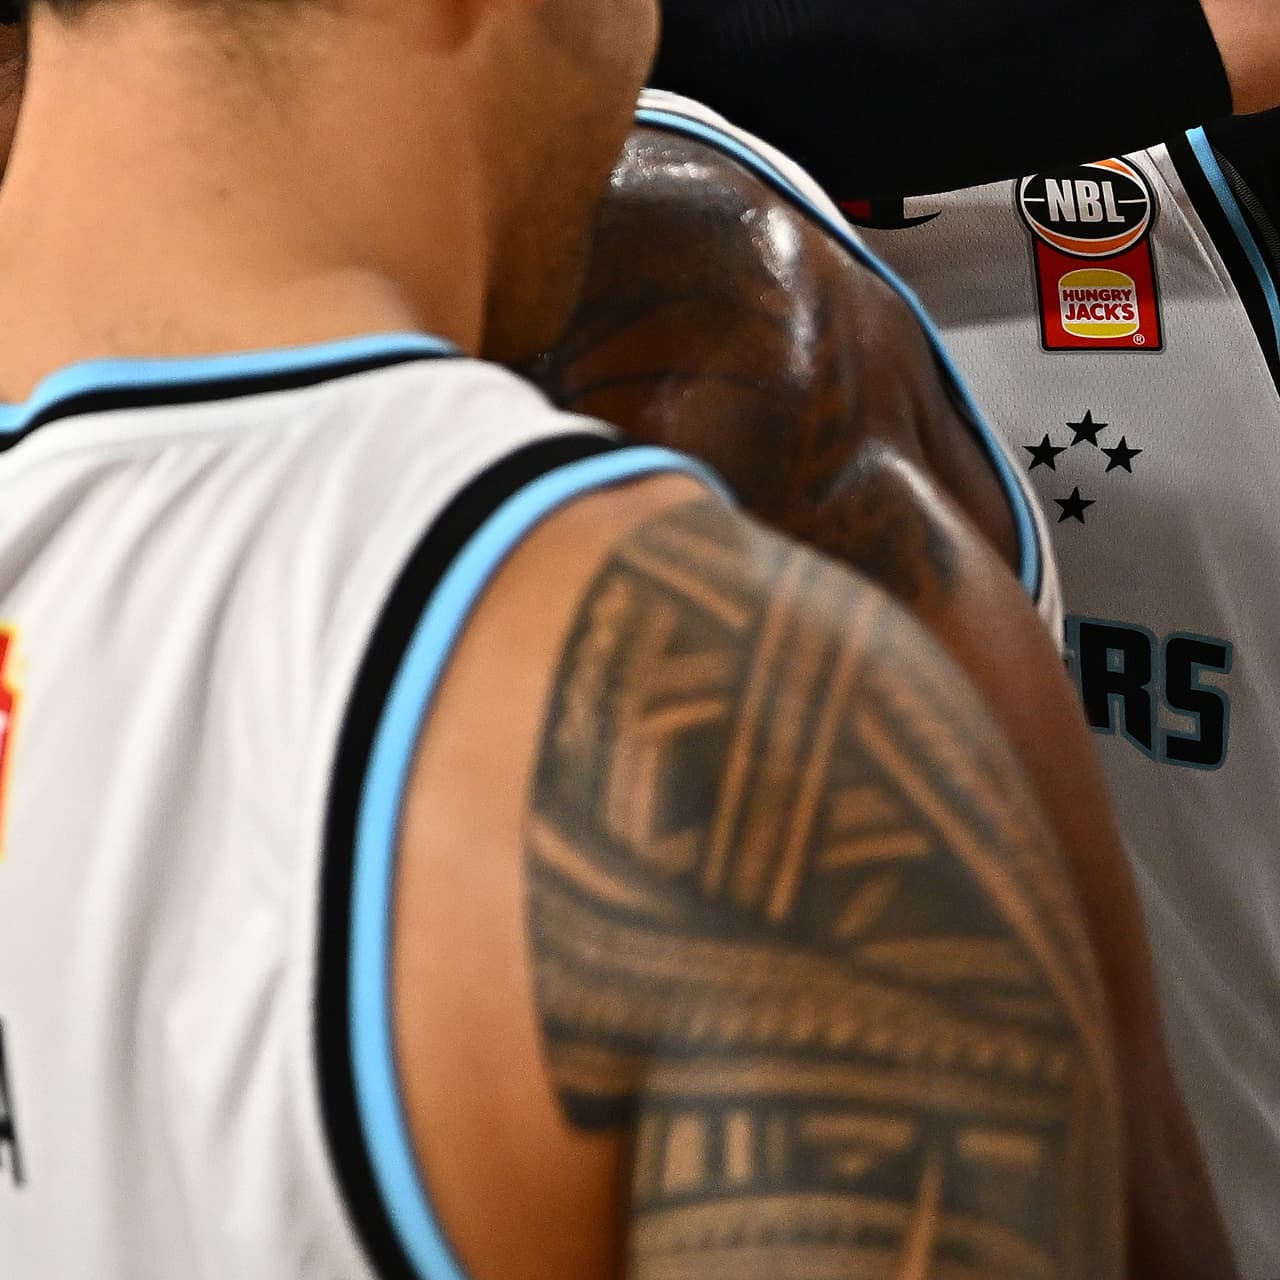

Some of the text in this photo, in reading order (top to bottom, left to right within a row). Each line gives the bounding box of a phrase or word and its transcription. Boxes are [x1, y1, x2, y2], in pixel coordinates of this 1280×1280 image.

[1044, 178, 1126, 223] NBL
[1062, 288, 1132, 302] HUNGRY
[1064, 302, 1135, 321] JACK'S
